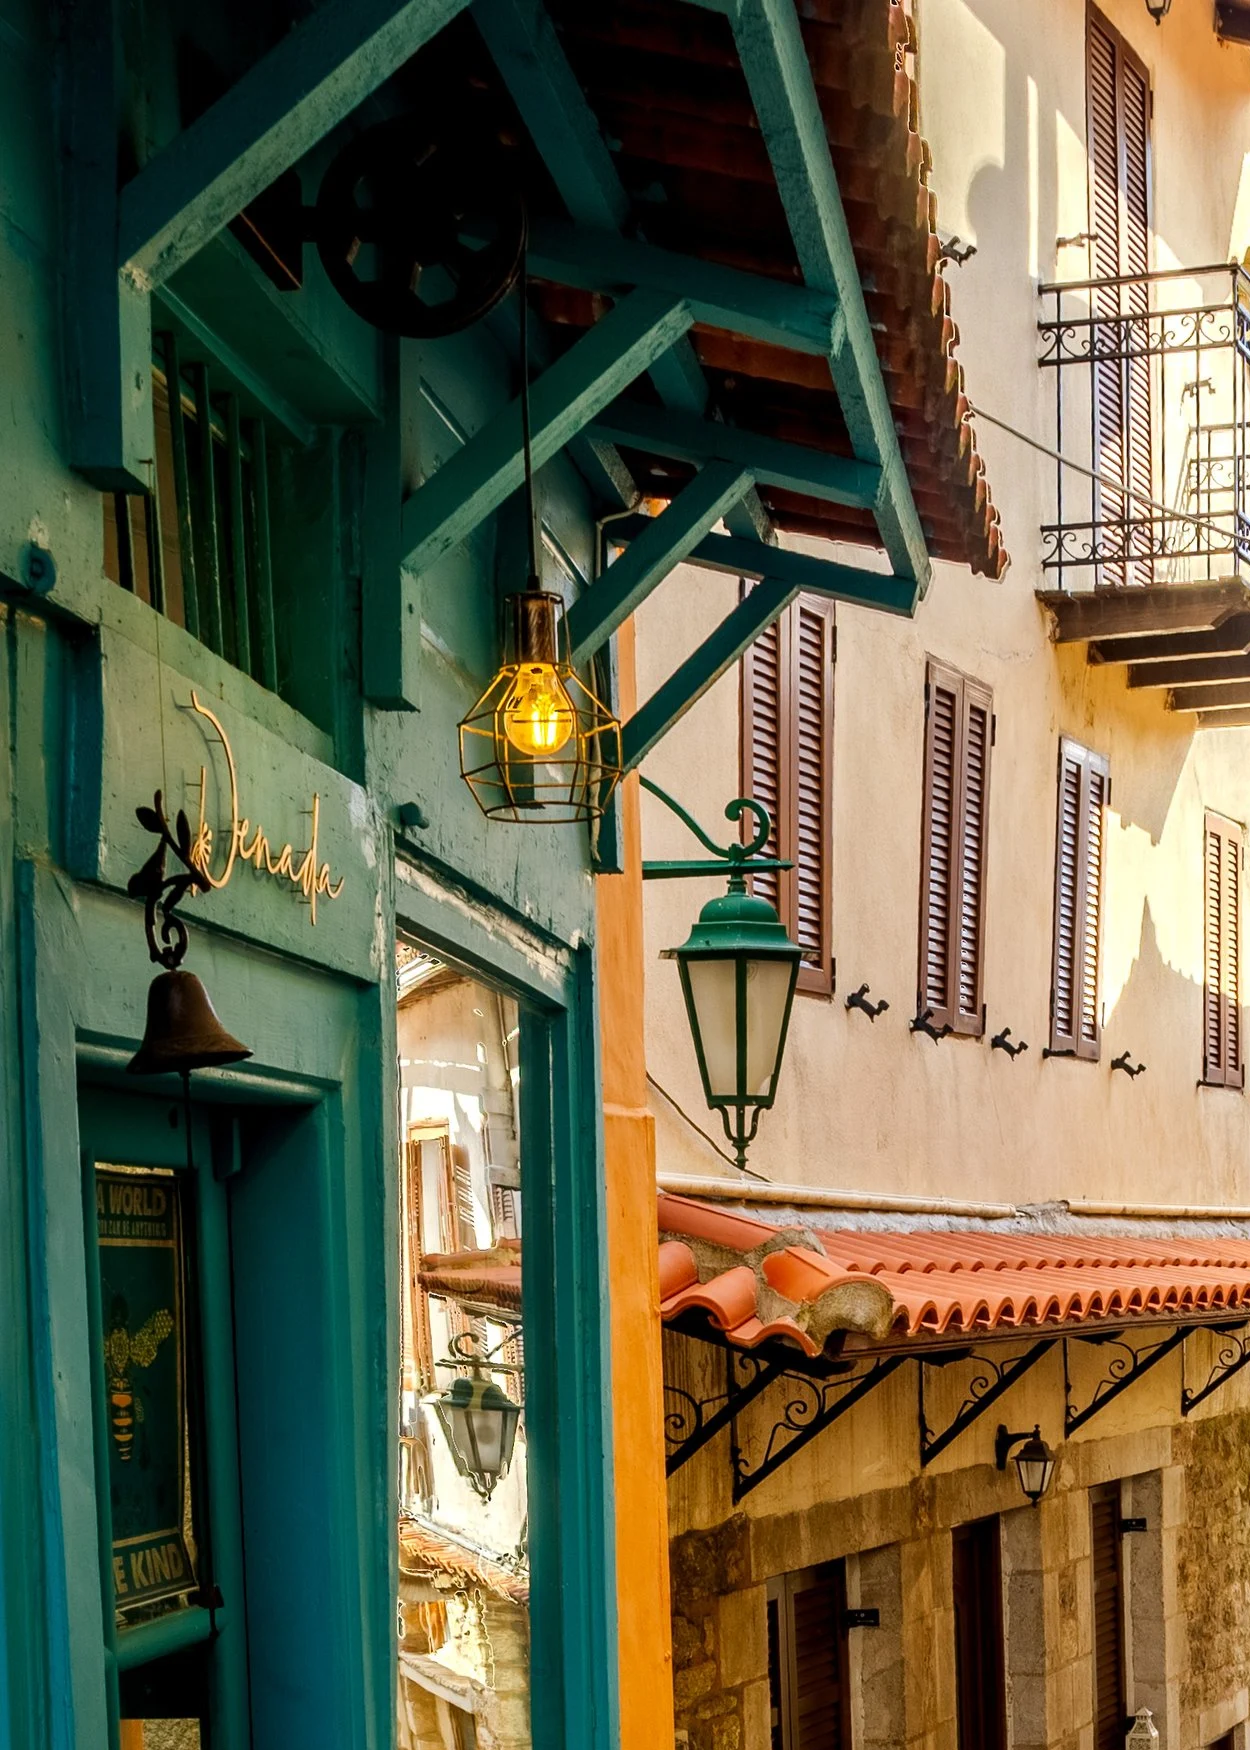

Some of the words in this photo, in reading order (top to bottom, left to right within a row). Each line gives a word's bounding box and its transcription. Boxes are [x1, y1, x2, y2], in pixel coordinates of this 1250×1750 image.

[109, 1184, 167, 1217] WORLD
[112, 1556, 129, 1595] E
[130, 1543, 184, 1590] KIND
